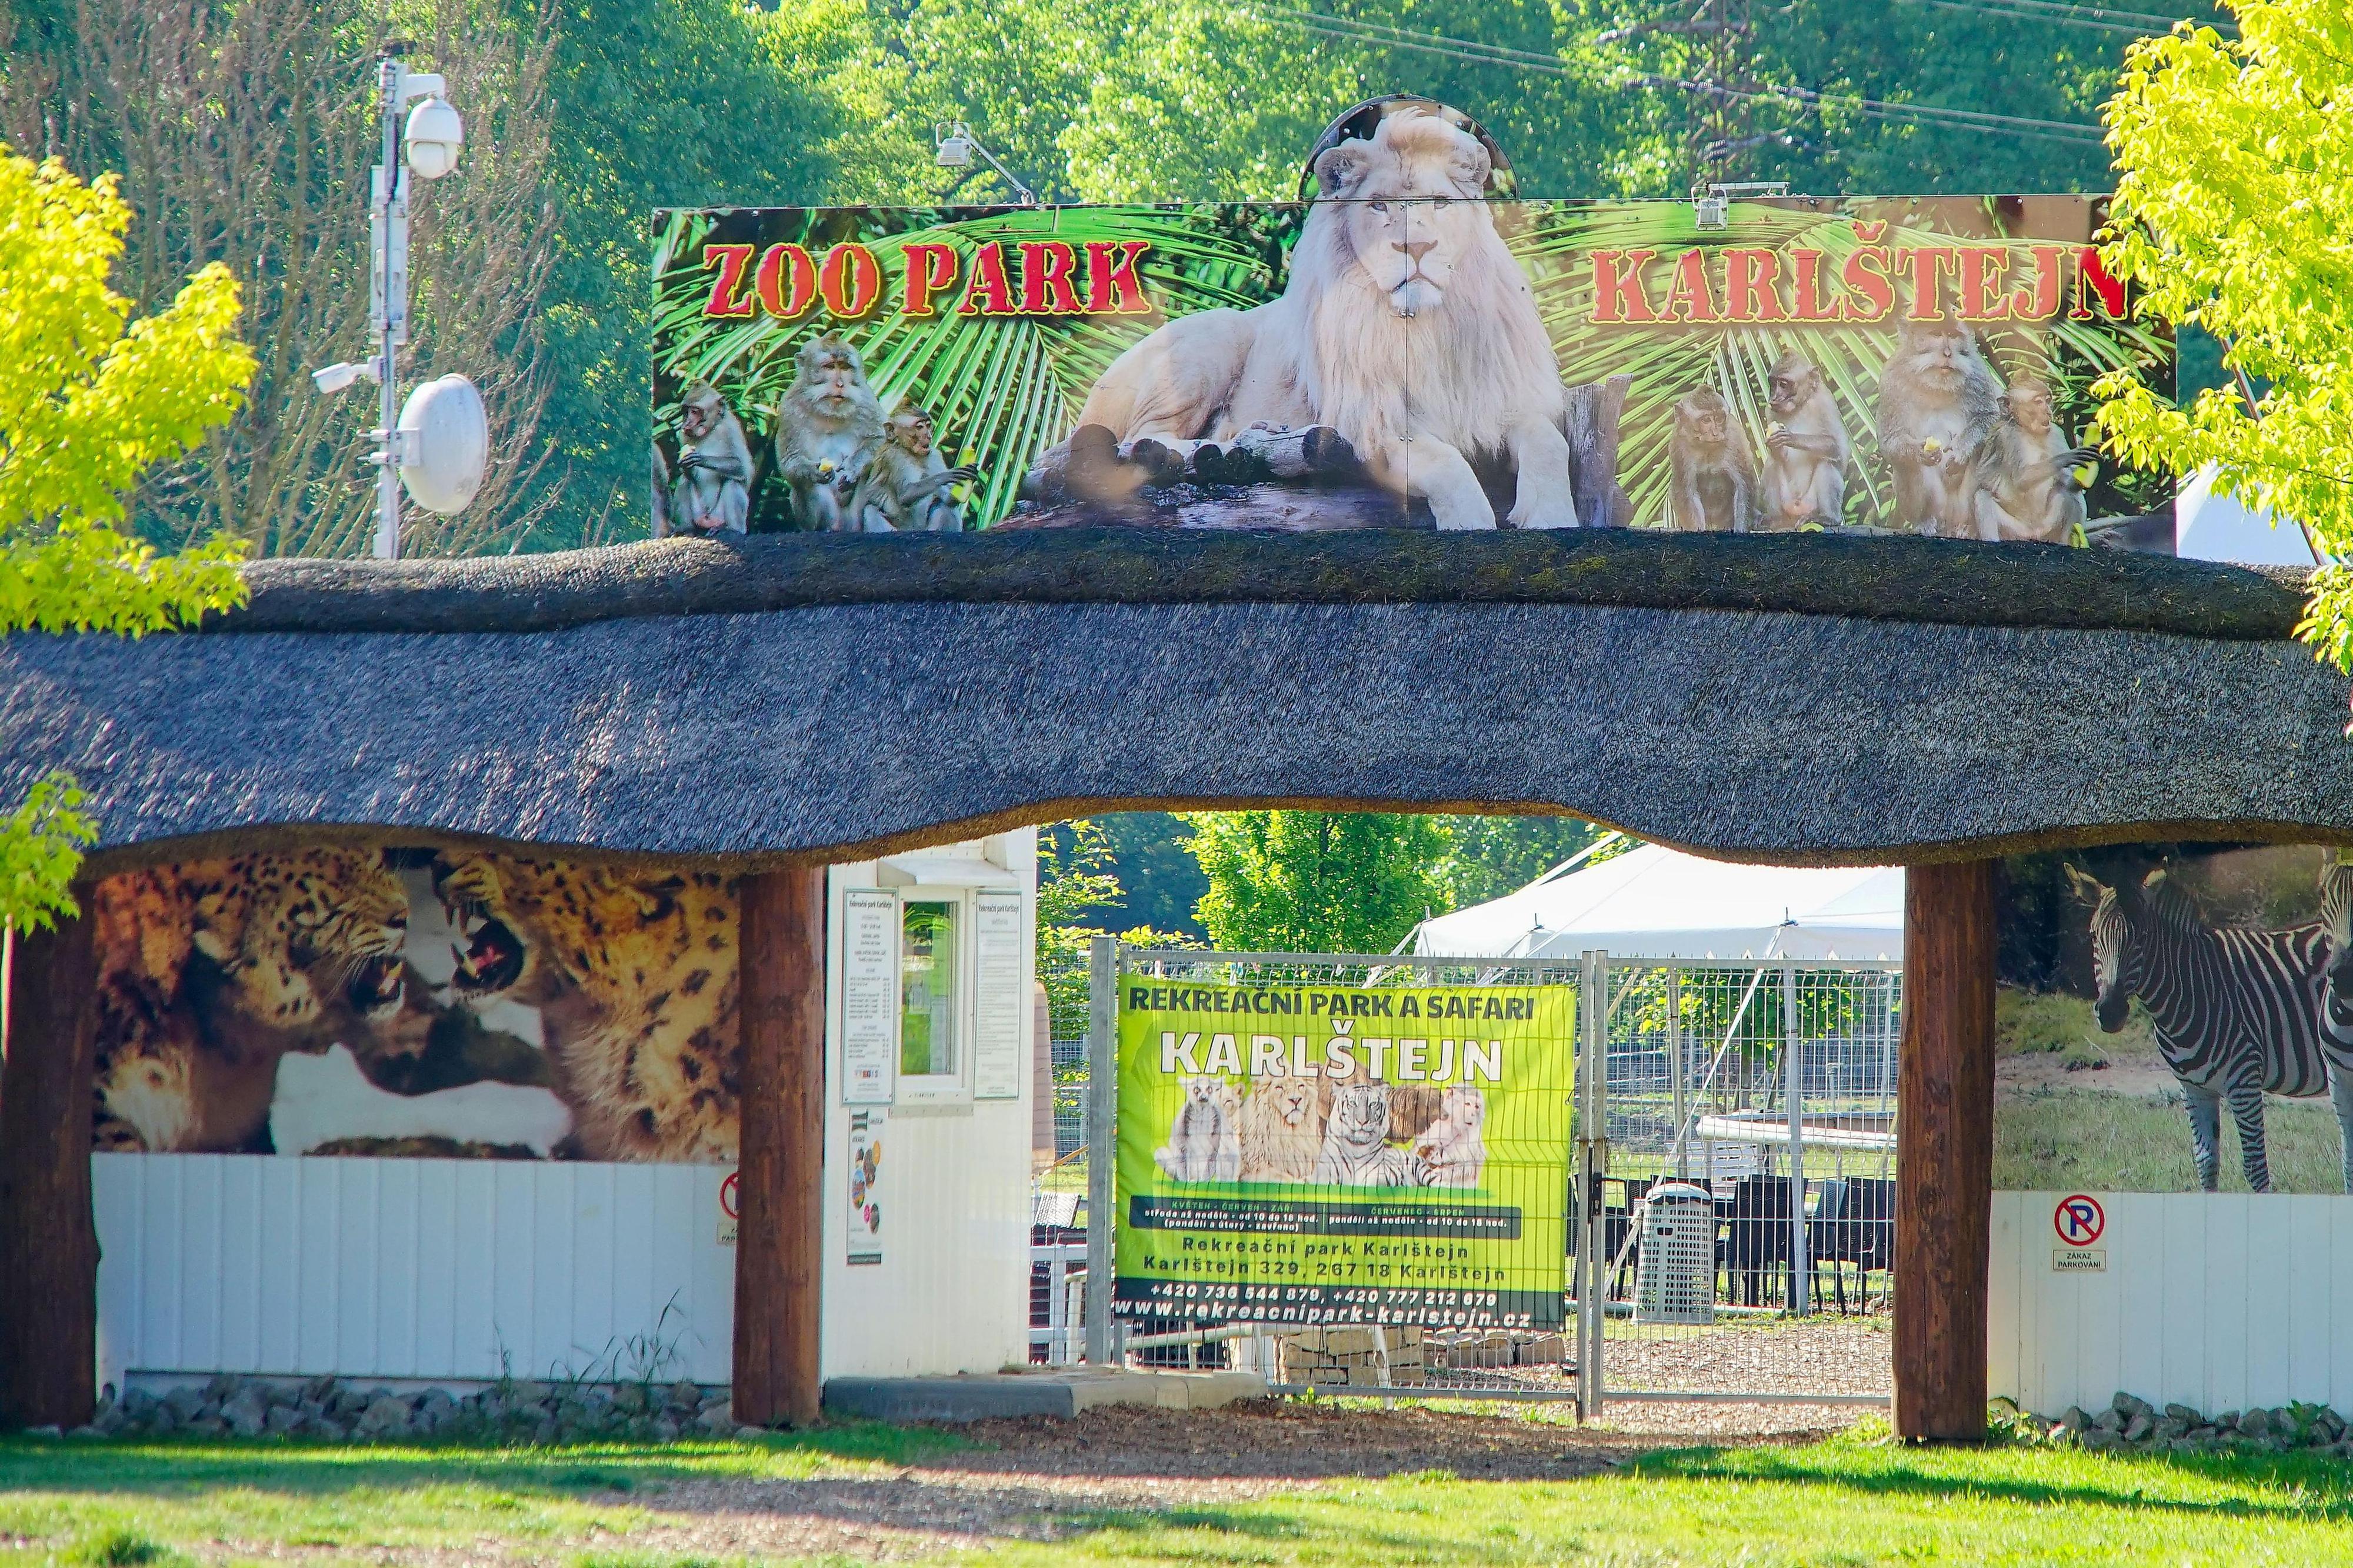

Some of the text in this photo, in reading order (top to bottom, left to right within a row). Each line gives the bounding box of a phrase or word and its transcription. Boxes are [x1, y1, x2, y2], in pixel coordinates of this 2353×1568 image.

[702, 219, 2128, 323] ZOO PARK KARLŠTEJN
[1129, 986, 1533, 1020] REKREAČNÍ PARK A SAFARI
[1161, 1019, 1502, 1082] KARLŠTEJN
[1239, 1212, 1250, 1221] od
[1268, 1213, 1280, 1222] do
[1427, 1217, 1438, 1226] od
[1457, 1217, 1468, 1226] do
[1183, 1237, 1468, 1260] Rekreační park Karlštejn
[1144, 1255, 1505, 1283] Karlštejn 329, 267 18 Karlštejn
[2058, 1260, 2101, 1269] PARKOVÁNÍ
[1151, 1283, 1198, 1299] +420
[1205, 1285, 1239, 1300] 736
[1333, 1289, 1379, 1303] +420
[1387, 1290, 1419, 1305] 777
[1425, 1291, 1456, 1306] 212
[1114, 1300, 1531, 1329] www.rekreacnipark-karlstejn.cz
